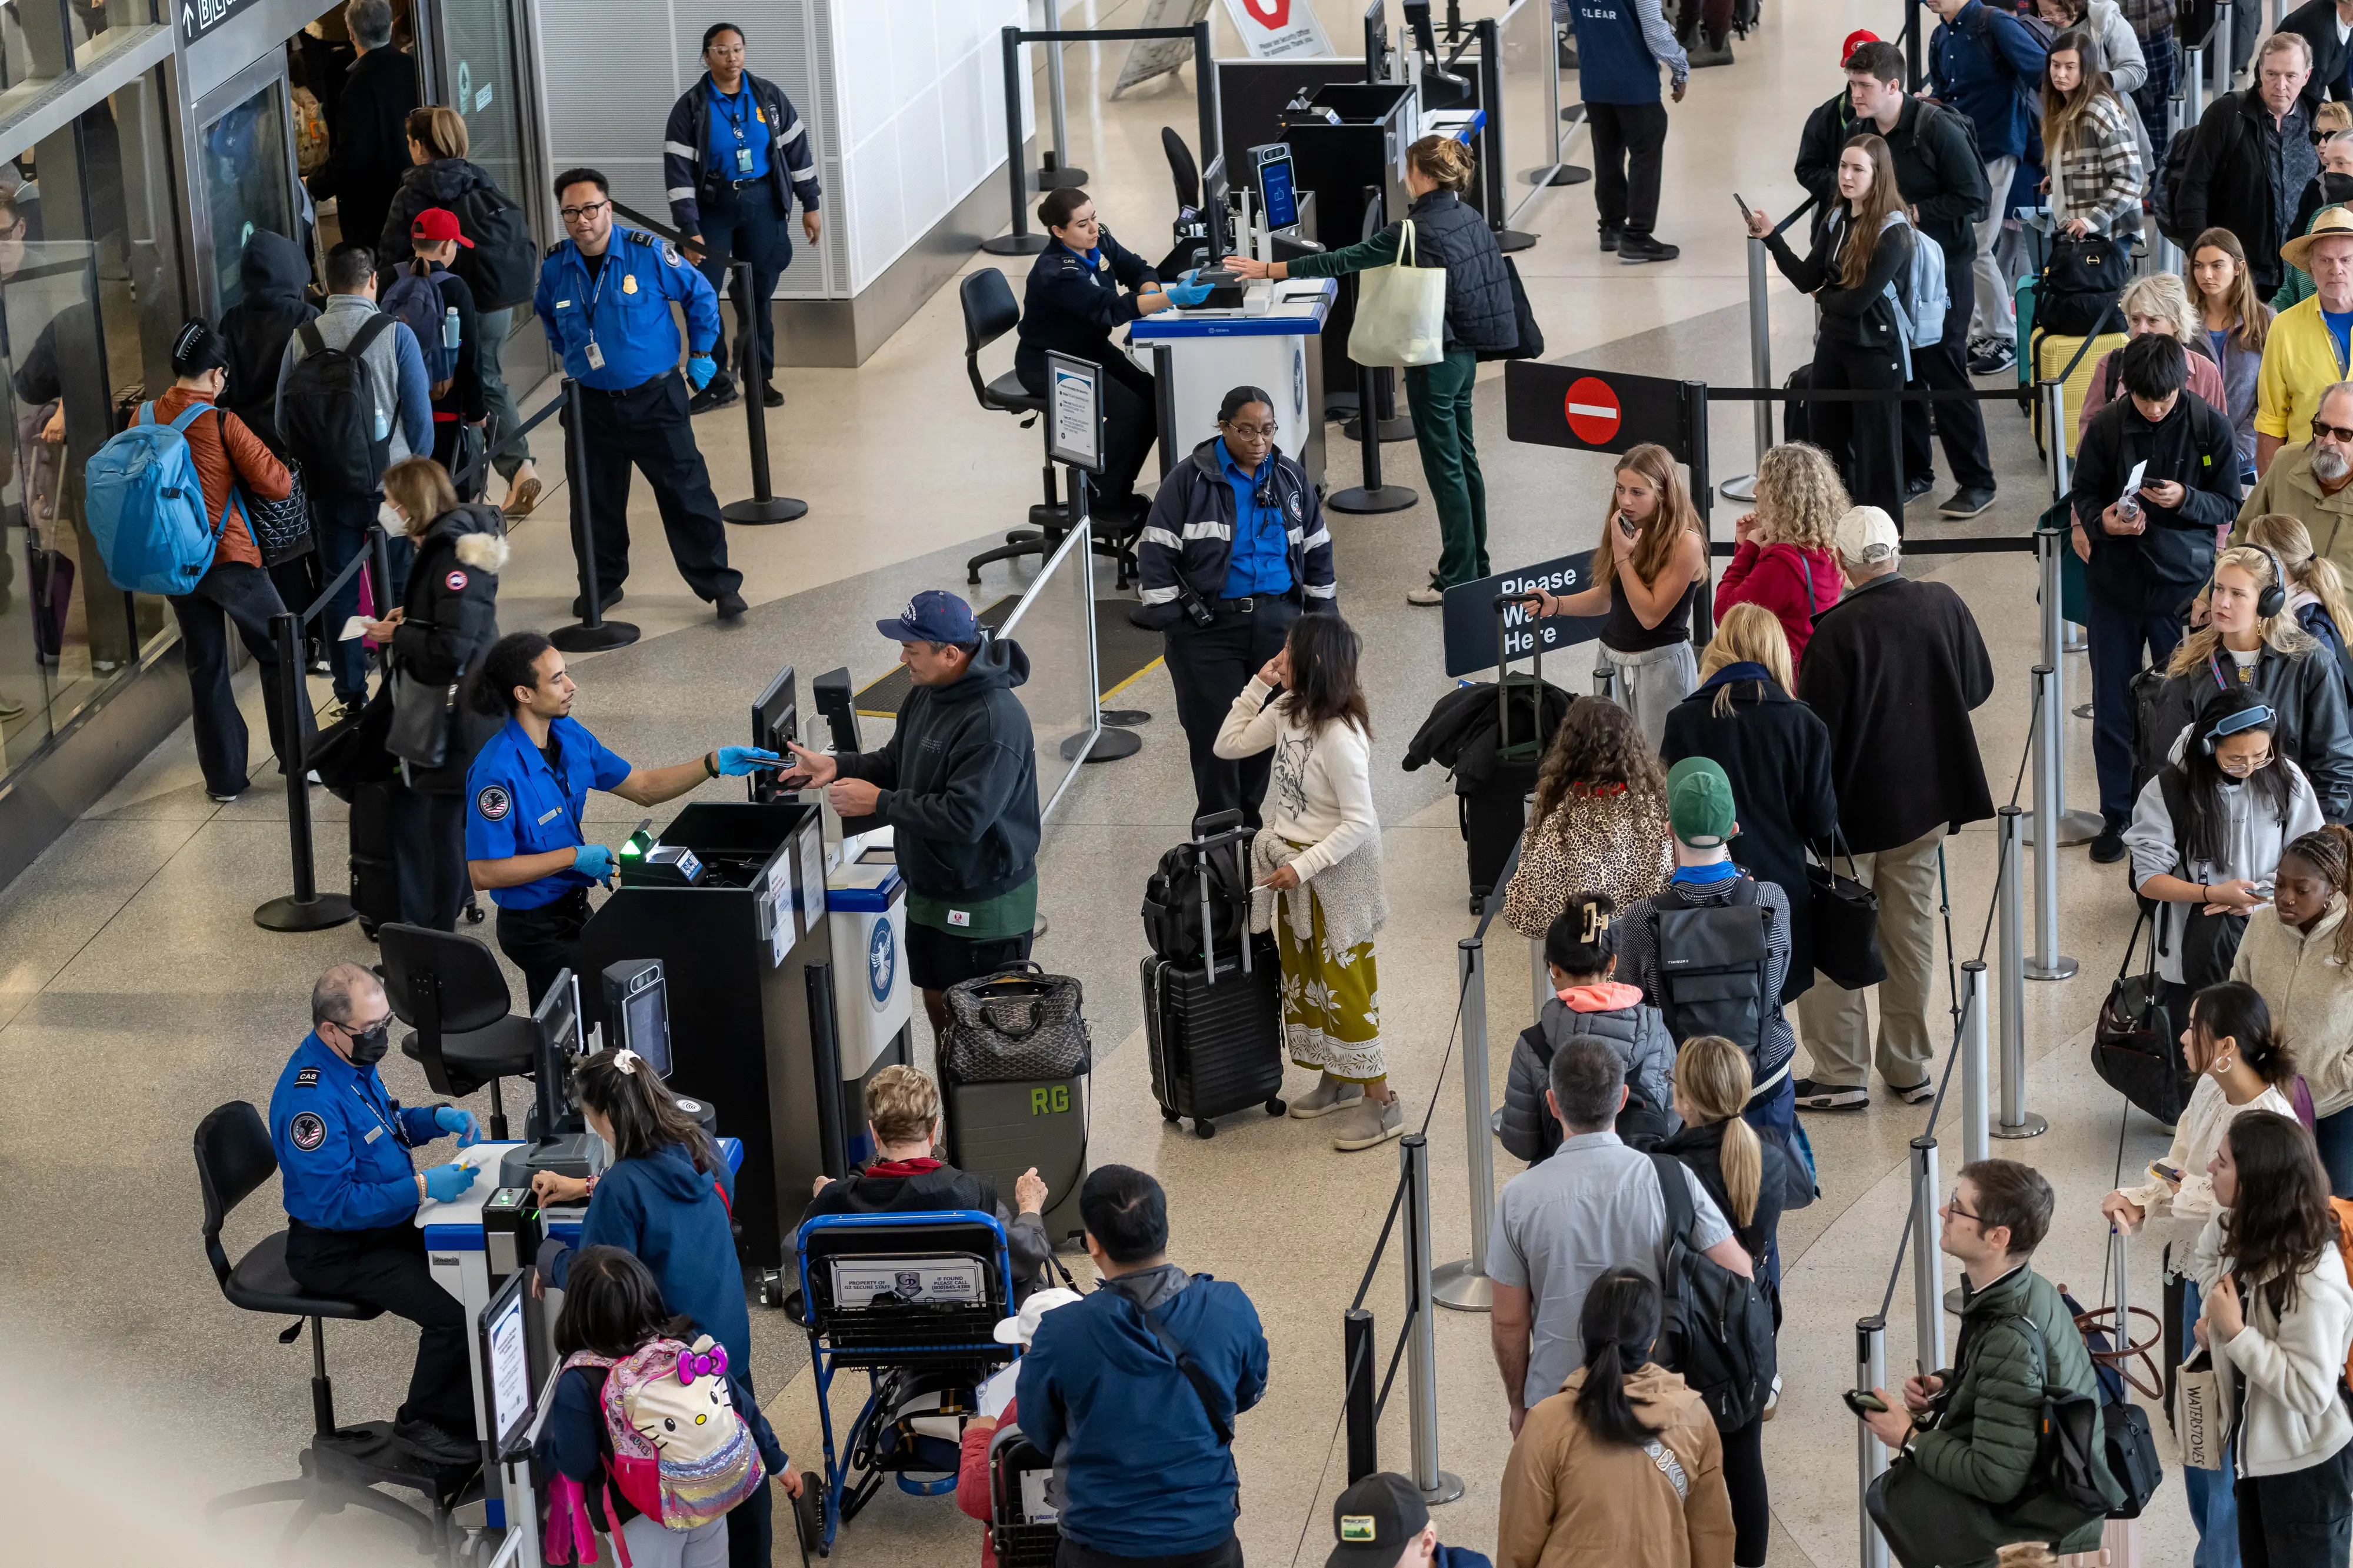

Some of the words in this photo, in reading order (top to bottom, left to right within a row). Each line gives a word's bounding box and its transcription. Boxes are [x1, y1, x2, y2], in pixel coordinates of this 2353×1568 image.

[1581, 8, 1617, 19] CLEAR
[1502, 569, 1577, 594] Please
[366, 1102, 377, 1115] SECURITY
[1031, 1085, 1069, 1115] RG
